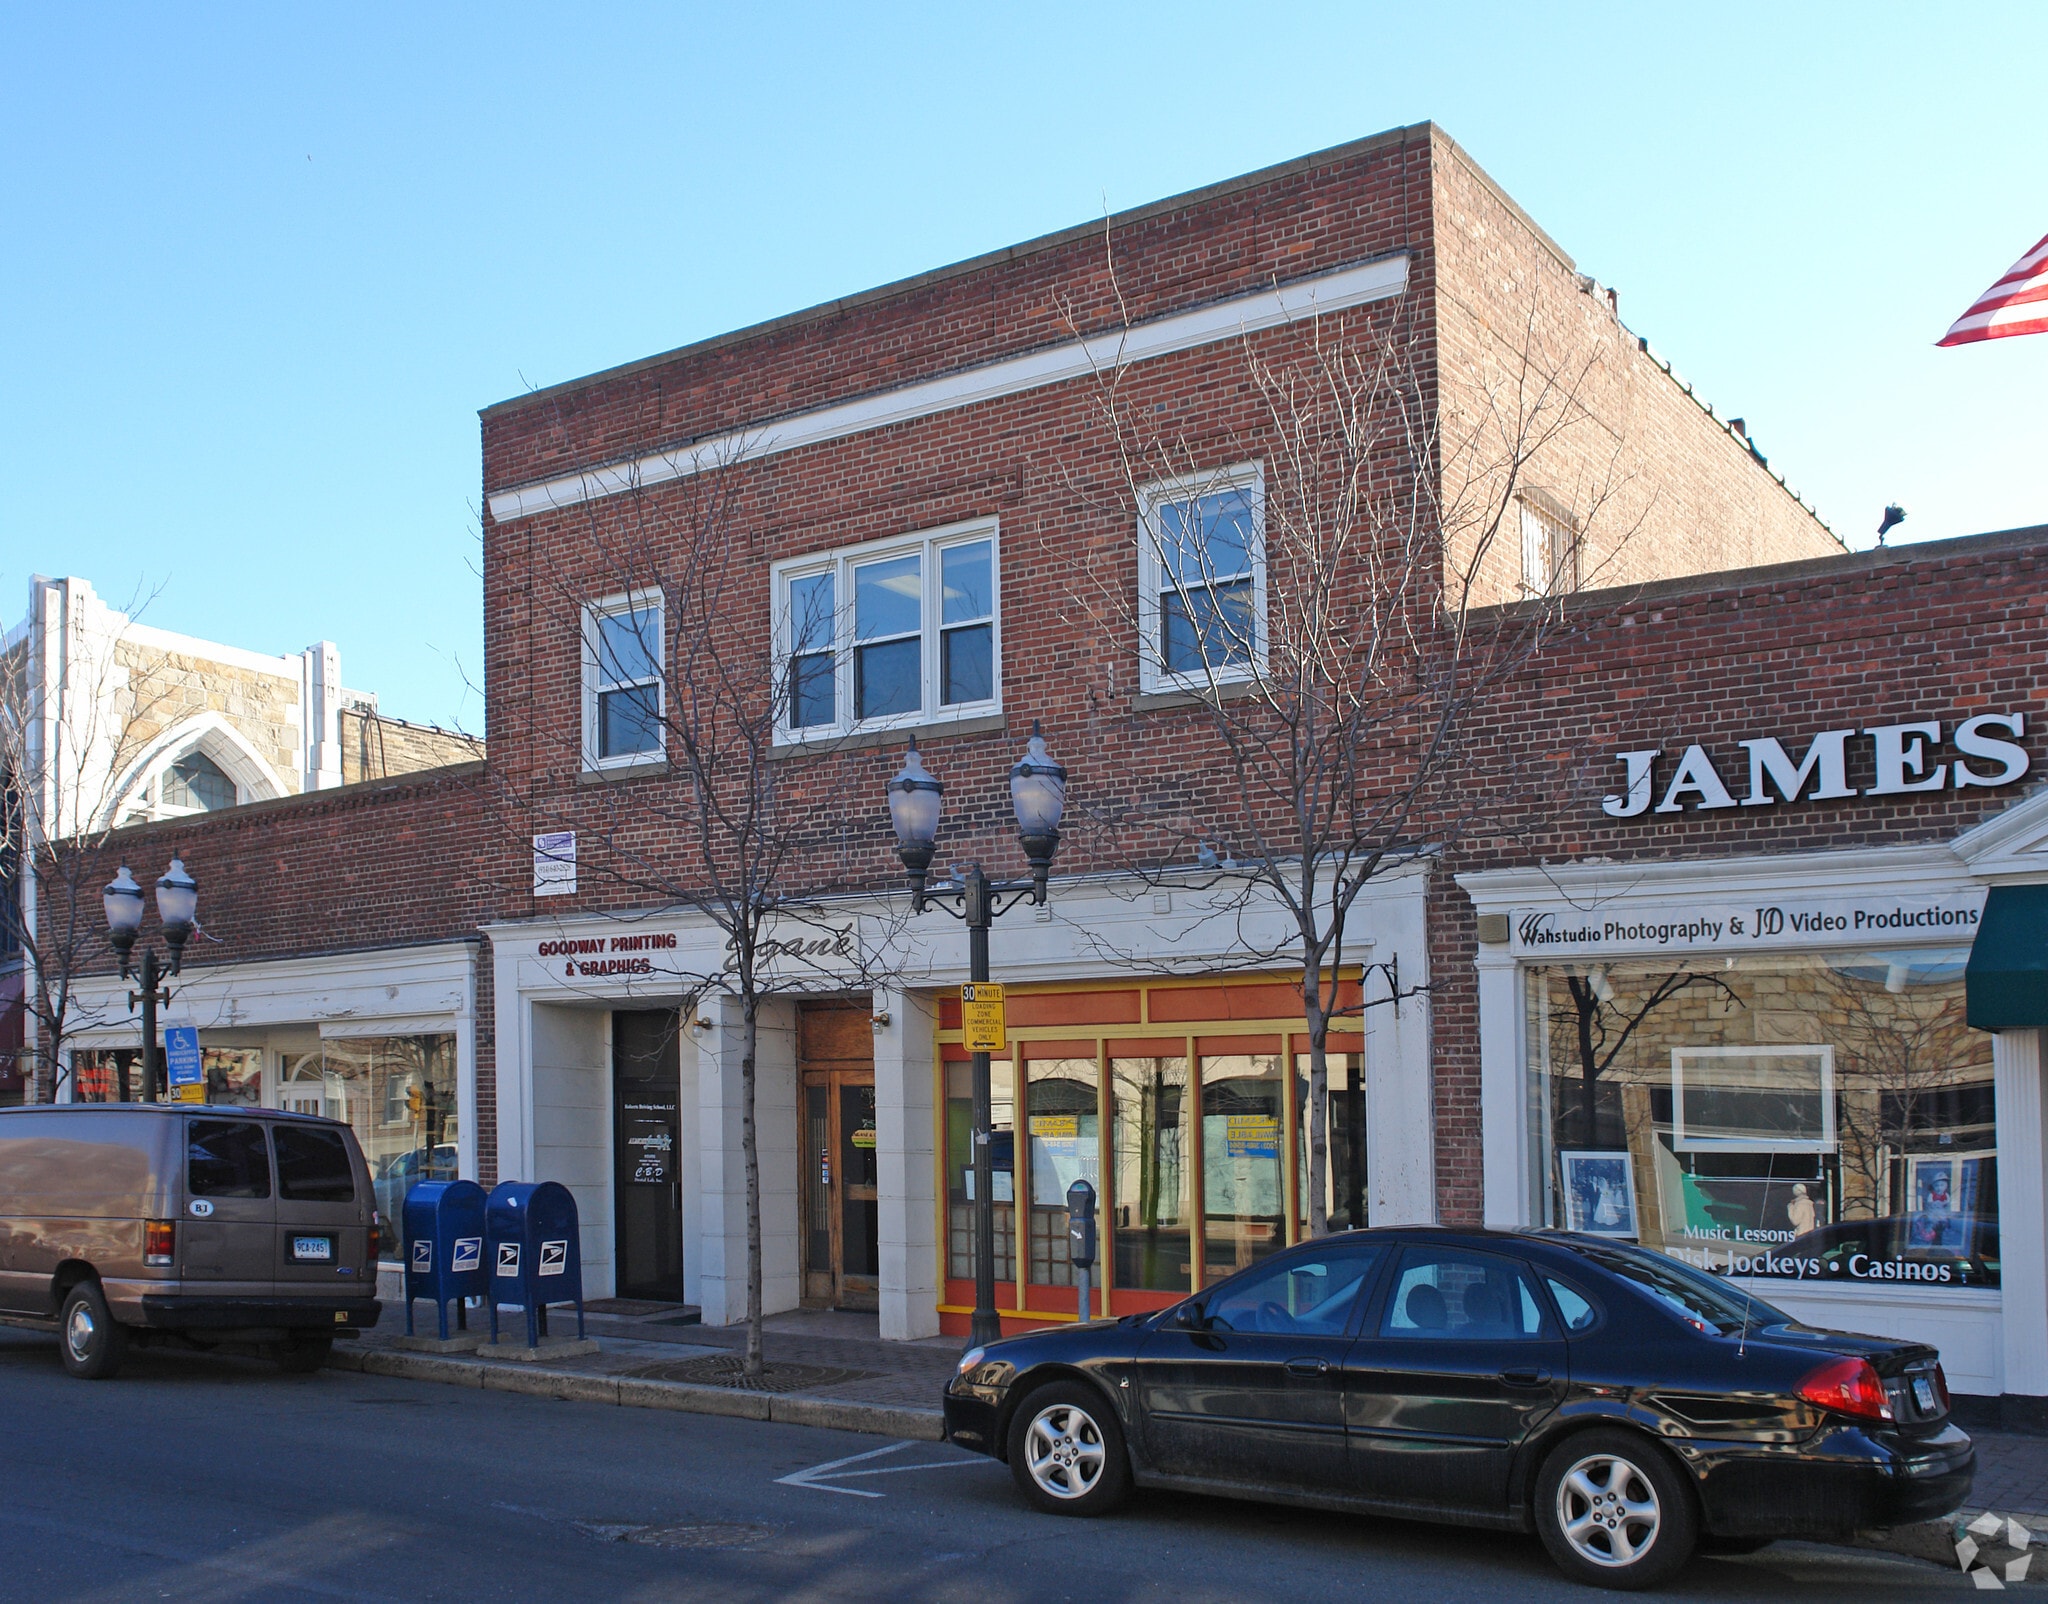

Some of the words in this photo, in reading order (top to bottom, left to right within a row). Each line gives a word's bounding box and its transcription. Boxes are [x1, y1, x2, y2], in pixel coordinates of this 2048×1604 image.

[1602, 712, 2030, 818] JAMES
[1518, 913, 1601, 947] Wahstudio
[1604, 917, 1723, 943] Photography
[1729, 916, 1745, 935] &
[1752, 907, 1784, 938] JD
[1790, 911, 1847, 932] Video
[1854, 906, 1978, 929] Productions
[538, 938, 606, 956] GOODWAY
[610, 933, 677, 952] PRINTING
[565, 962, 575, 977] &
[580, 957, 650, 976] GRAPHICS
[963, 986, 975, 1000] 30
[977, 988, 1000, 998] MINUTE
[977, 1010, 991, 1018] ZONE
[171, 1087, 181, 1099] 30
[1683, 1223, 1730, 1241] Music
[1735, 1225, 1795, 1243] Lessons
[1727, 1250, 1820, 1279] Jockeys
[1849, 1254, 1951, 1282] Casinos
